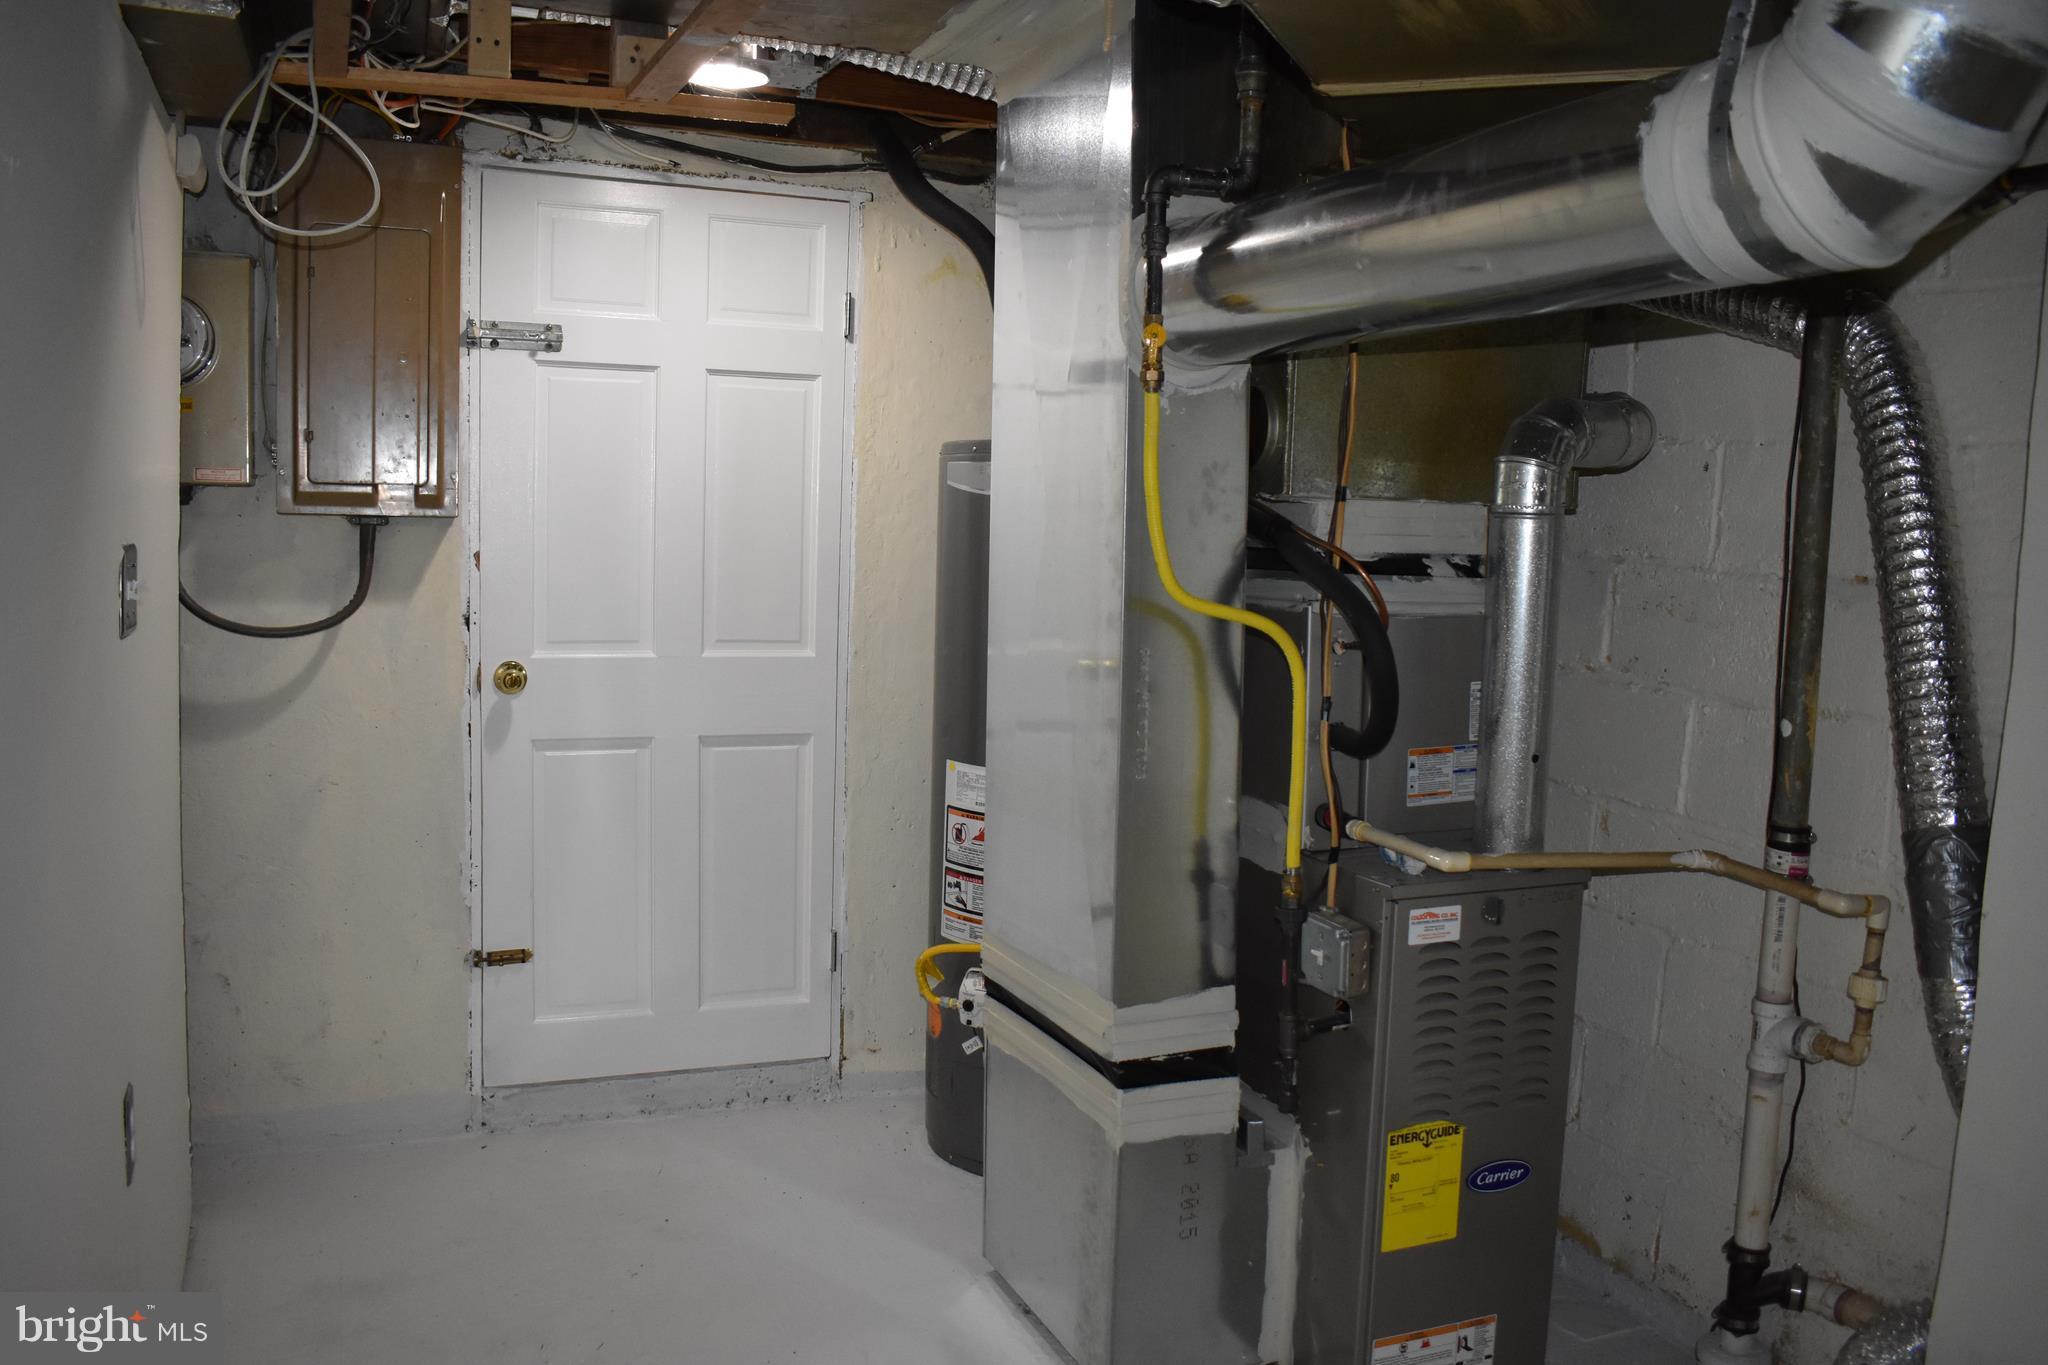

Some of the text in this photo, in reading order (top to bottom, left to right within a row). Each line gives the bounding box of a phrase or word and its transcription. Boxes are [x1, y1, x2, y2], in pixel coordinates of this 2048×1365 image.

[1390, 1125, 1461, 1148] ENERGYGUIDE
[1390, 1172, 1400, 1183] 80
[1476, 1166, 1525, 1186] Carrier
